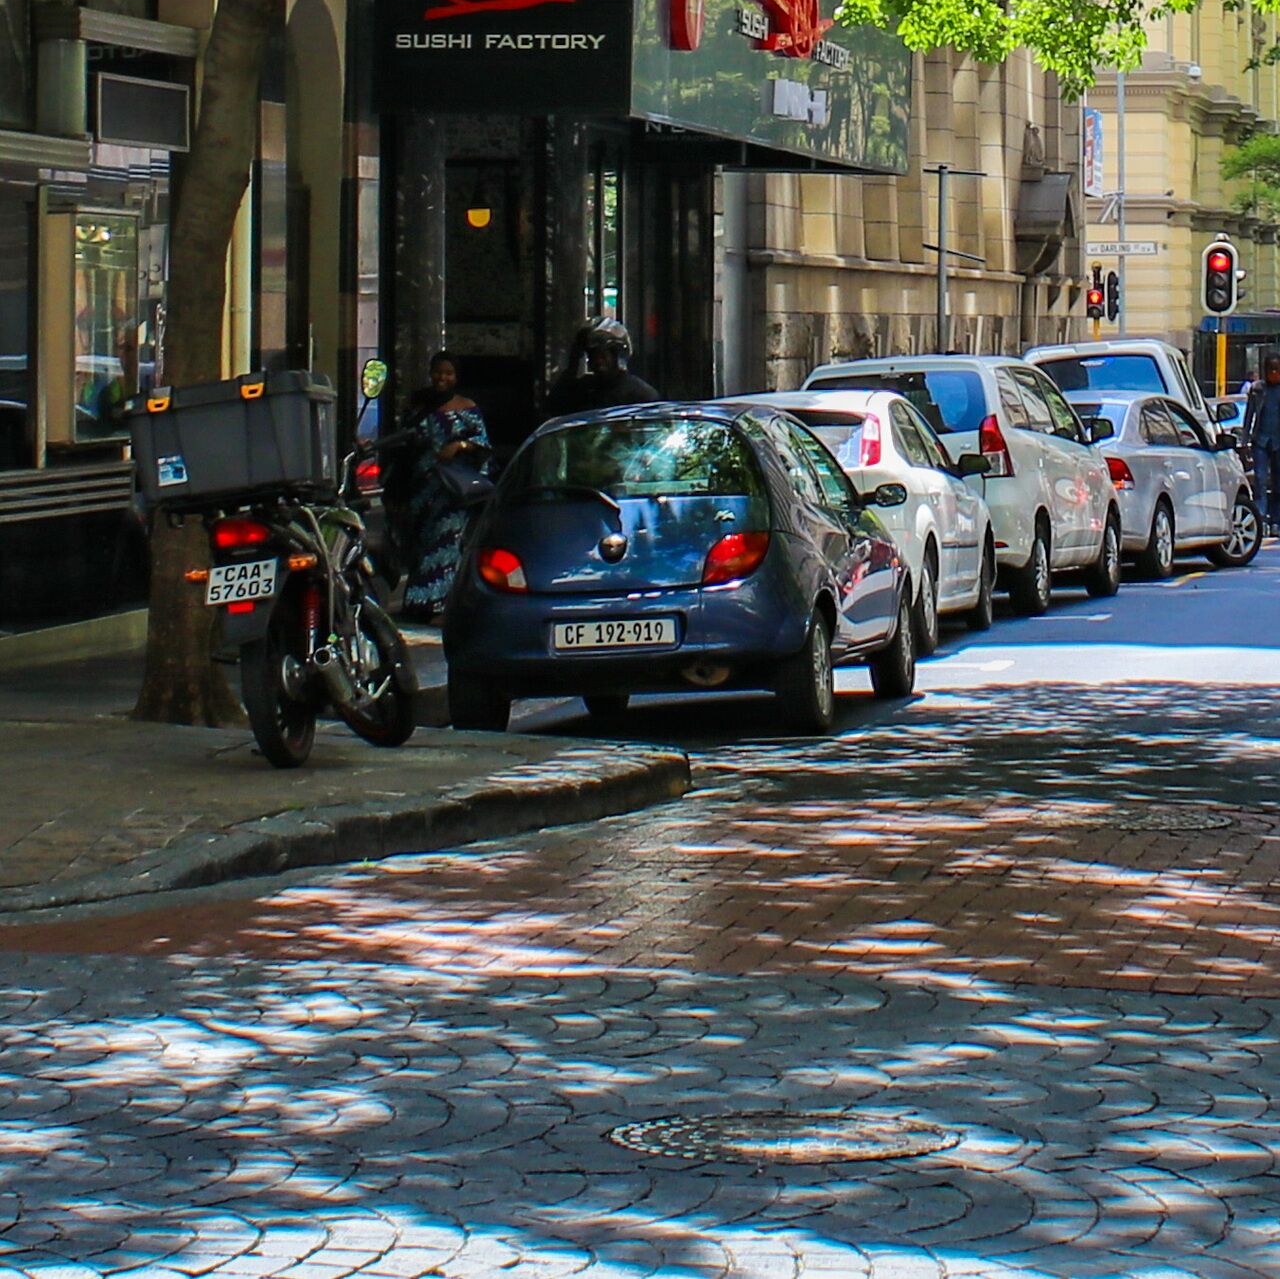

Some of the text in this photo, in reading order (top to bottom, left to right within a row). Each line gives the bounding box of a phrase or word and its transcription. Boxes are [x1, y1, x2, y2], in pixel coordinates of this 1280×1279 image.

[394, 33, 607, 50] SUSHI FACTORY
[1099, 243, 1131, 253] DARLING
[223, 563, 262, 583] CAA
[209, 577, 274, 602] 57603
[564, 621, 664, 645] CF 192-919
